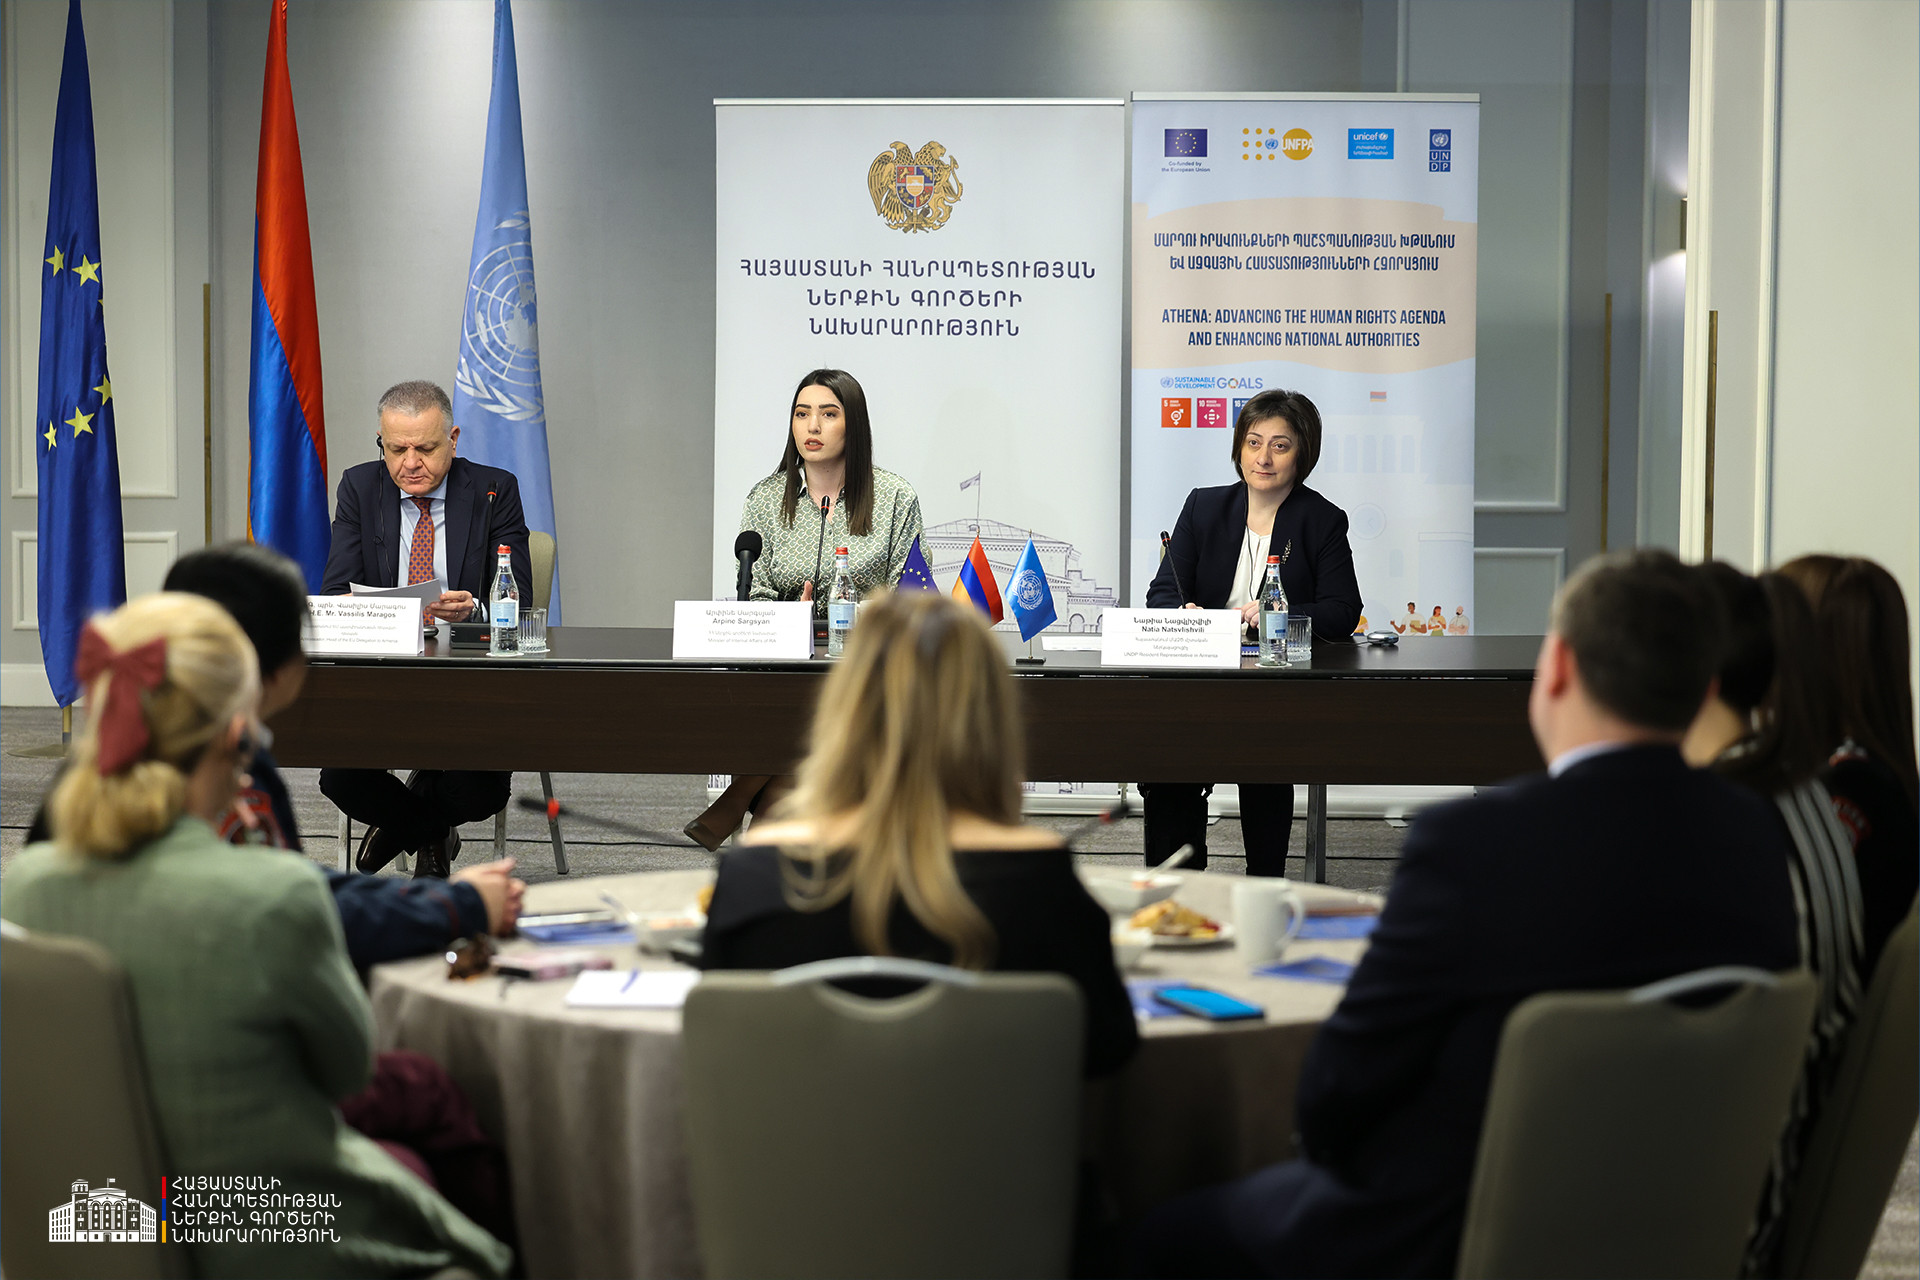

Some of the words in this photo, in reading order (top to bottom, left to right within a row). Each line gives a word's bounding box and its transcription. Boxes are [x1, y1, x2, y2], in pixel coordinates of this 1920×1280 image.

[1353, 132, 1378, 140] unicef
[1282, 138, 1313, 150] UNFPA
[1154, 233, 1197, 247] ՄԱՐԴՈՒ
[1200, 233, 1289, 247] ԻՐԱՎՈՒՆՔՆԵՐԻ
[1294, 233, 1396, 248] ՊԱՇՏՊԱՆՈՒԹՅԱՆ
[1400, 234, 1455, 248] ԽԹԱՆՈՒՄ
[740, 259, 871, 277] ՀԱՅԱՍՏԱՆԻ
[883, 260, 1095, 279] ՀԱՆՐԱՊԵՏՈՒԹՅԱՆ
[1170, 256, 1184, 269] ԵՎ
[1188, 256, 1242, 269] ԱԶԳԱՅԻՆ
[1246, 256, 1370, 270] ՀԱՍՏԱՏՈՒԹՅՈՒՆՆԵՐԻ
[1374, 256, 1439, 271] ՀԶՈՐԱՑՈՒՄ
[807, 289, 900, 307] ՆԵՐՔԻՆ
[911, 290, 1022, 308] ԳՈՐԾԵՐԻ
[1162, 309, 1211, 323] ATHENA:
[1215, 309, 1281, 324] ADVANCING
[1285, 309, 1306, 324] THE
[1310, 310, 1352, 324] HUMAN
[1356, 310, 1397, 324] RIGHTS
[1400, 310, 1446, 324] AGENDA
[810, 318, 1018, 337] ՆԱԽԱՐԱՐՈՒԹՅՈՒՆ
[1189, 331, 1212, 346] AND
[1215, 331, 1281, 346] ENHANCING
[1285, 332, 1341, 346] NATIONAL
[1345, 332, 1420, 347] AUTHORITIES
[1217, 377, 1263, 389] GOALS
